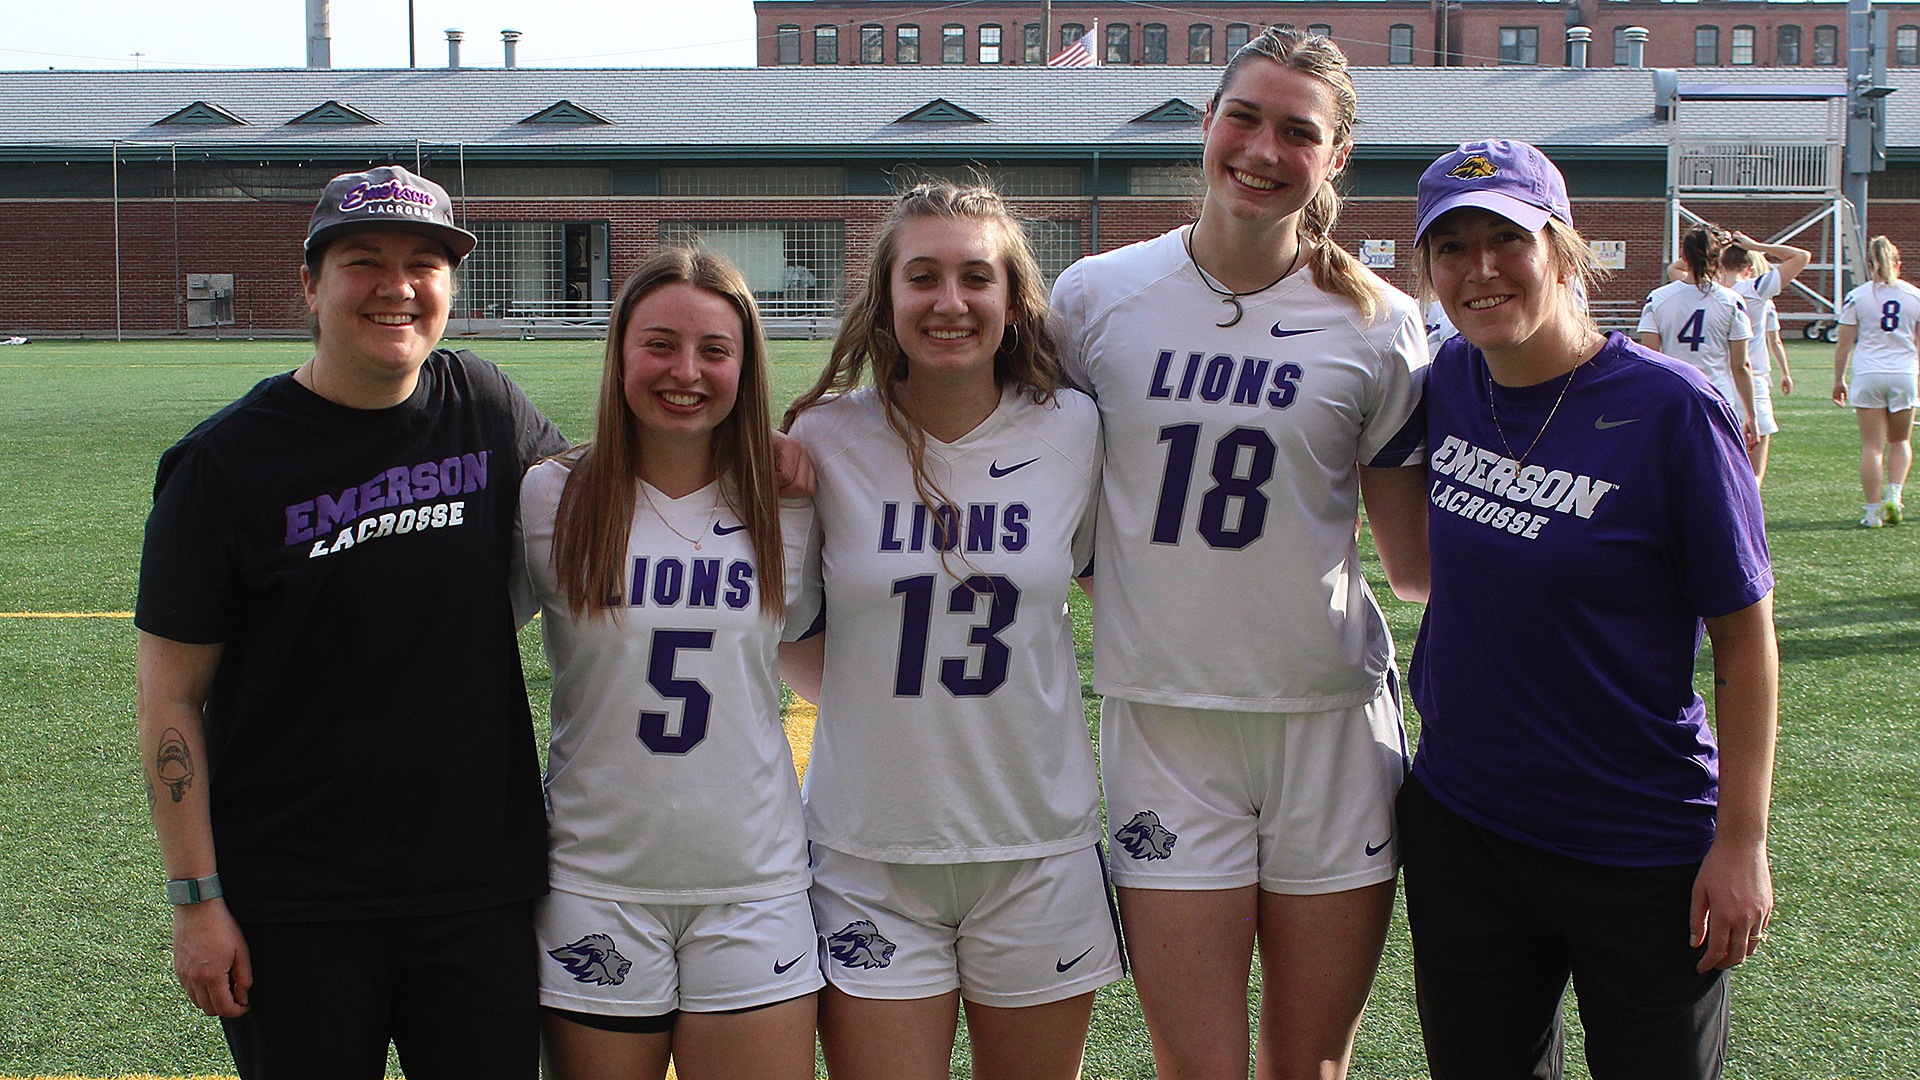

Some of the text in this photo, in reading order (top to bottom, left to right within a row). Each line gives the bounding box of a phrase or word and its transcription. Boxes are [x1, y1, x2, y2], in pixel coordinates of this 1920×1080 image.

[340, 179, 437, 212] Emerson
[1677, 309, 1706, 351] 4
[1880, 300, 1901, 332] 8
[1146, 349, 1305, 411] LIONS
[284, 451, 488, 547] EMERSON
[1149, 421, 1279, 551] 18
[1431, 435, 1613, 519] EMERSON
[309, 501, 465, 559] LACROSSE
[878, 501, 1031, 554] LIONS
[1430, 480, 1550, 540] LACROSSE
[890, 573, 1022, 698] 13
[635, 628, 717, 756] 5
